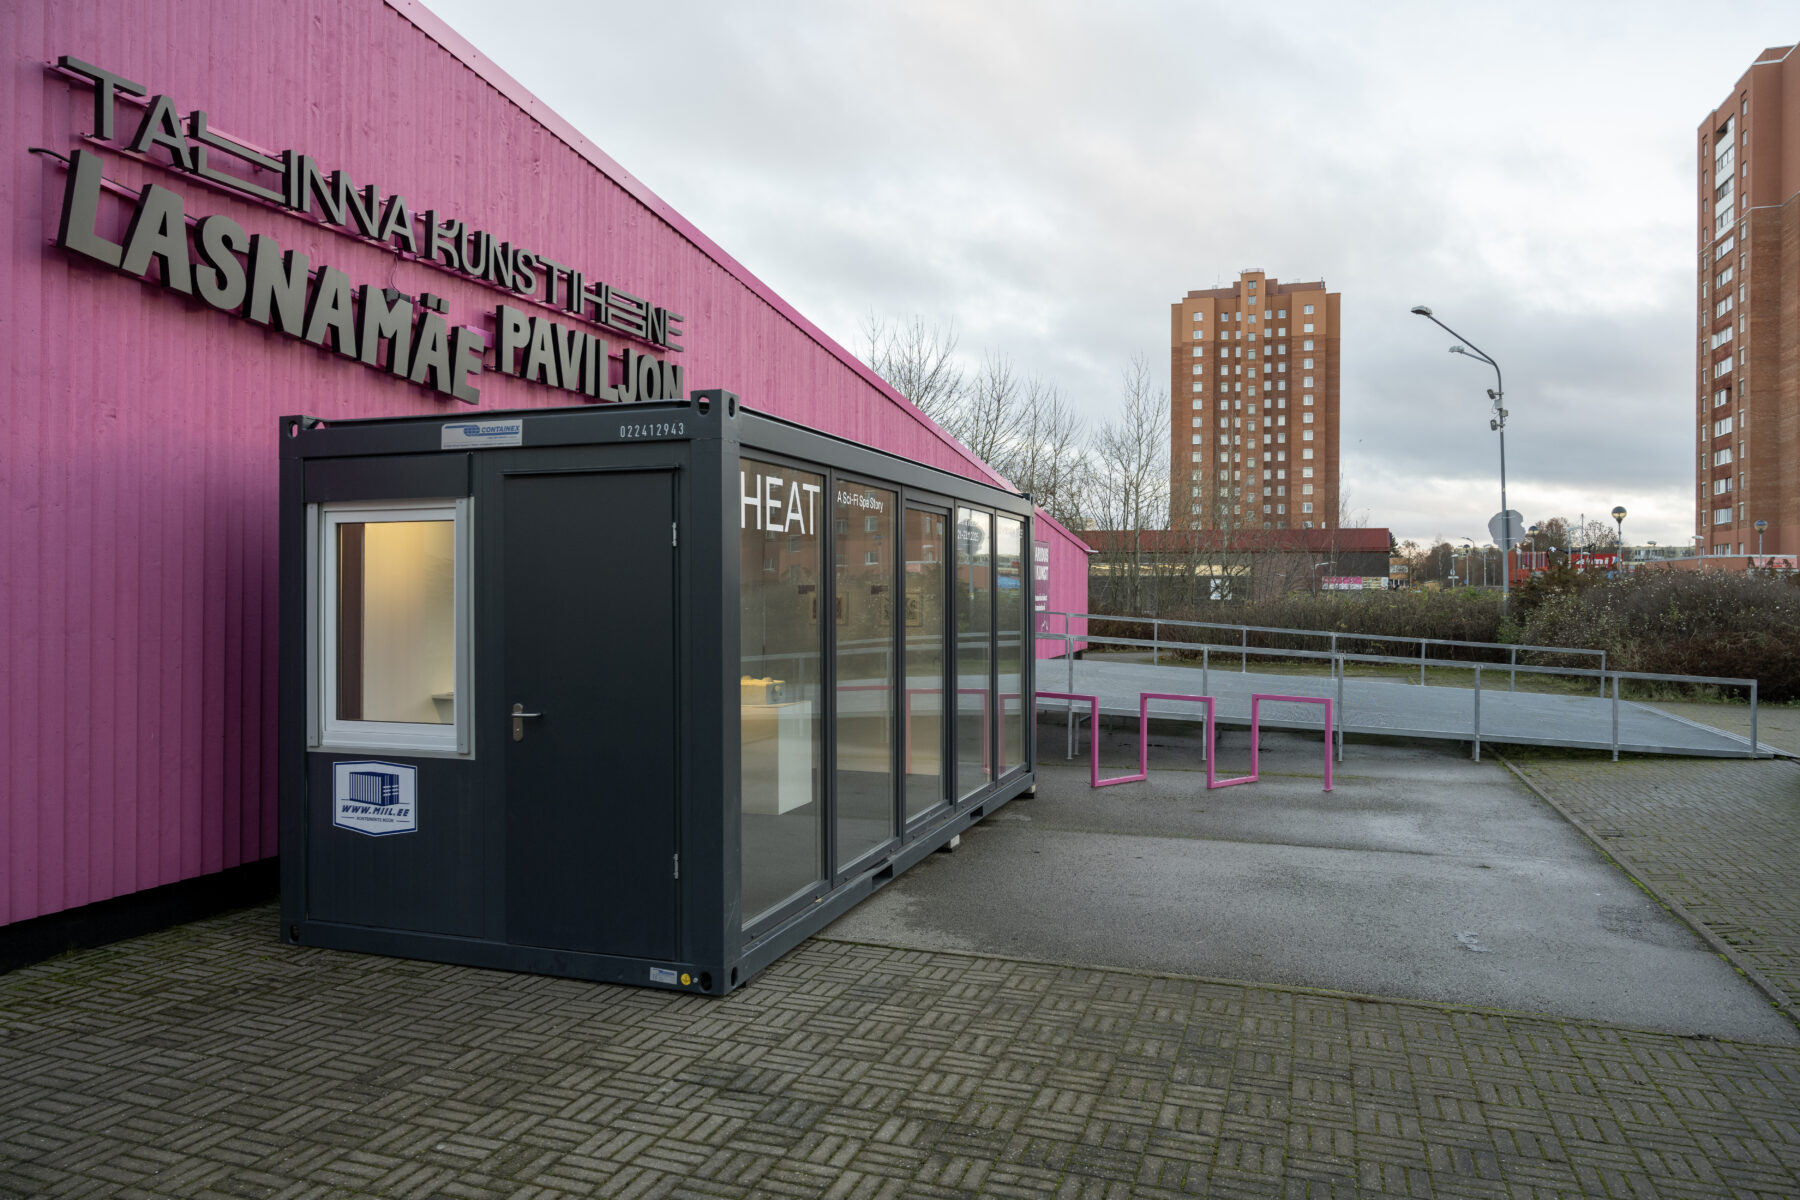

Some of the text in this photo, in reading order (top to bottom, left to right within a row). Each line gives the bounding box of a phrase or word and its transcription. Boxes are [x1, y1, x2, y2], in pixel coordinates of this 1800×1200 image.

[58, 149, 684, 406] LASNAMÄE PAVILJON
[481, 425, 520, 433] CONTAINEX
[620, 422, 685, 438] 022412943
[740, 470, 821, 535] HEAT
[837, 490, 883, 512] A Sci-Fi Spa Story
[342, 805, 410, 816] WWW.MIIL.EE
